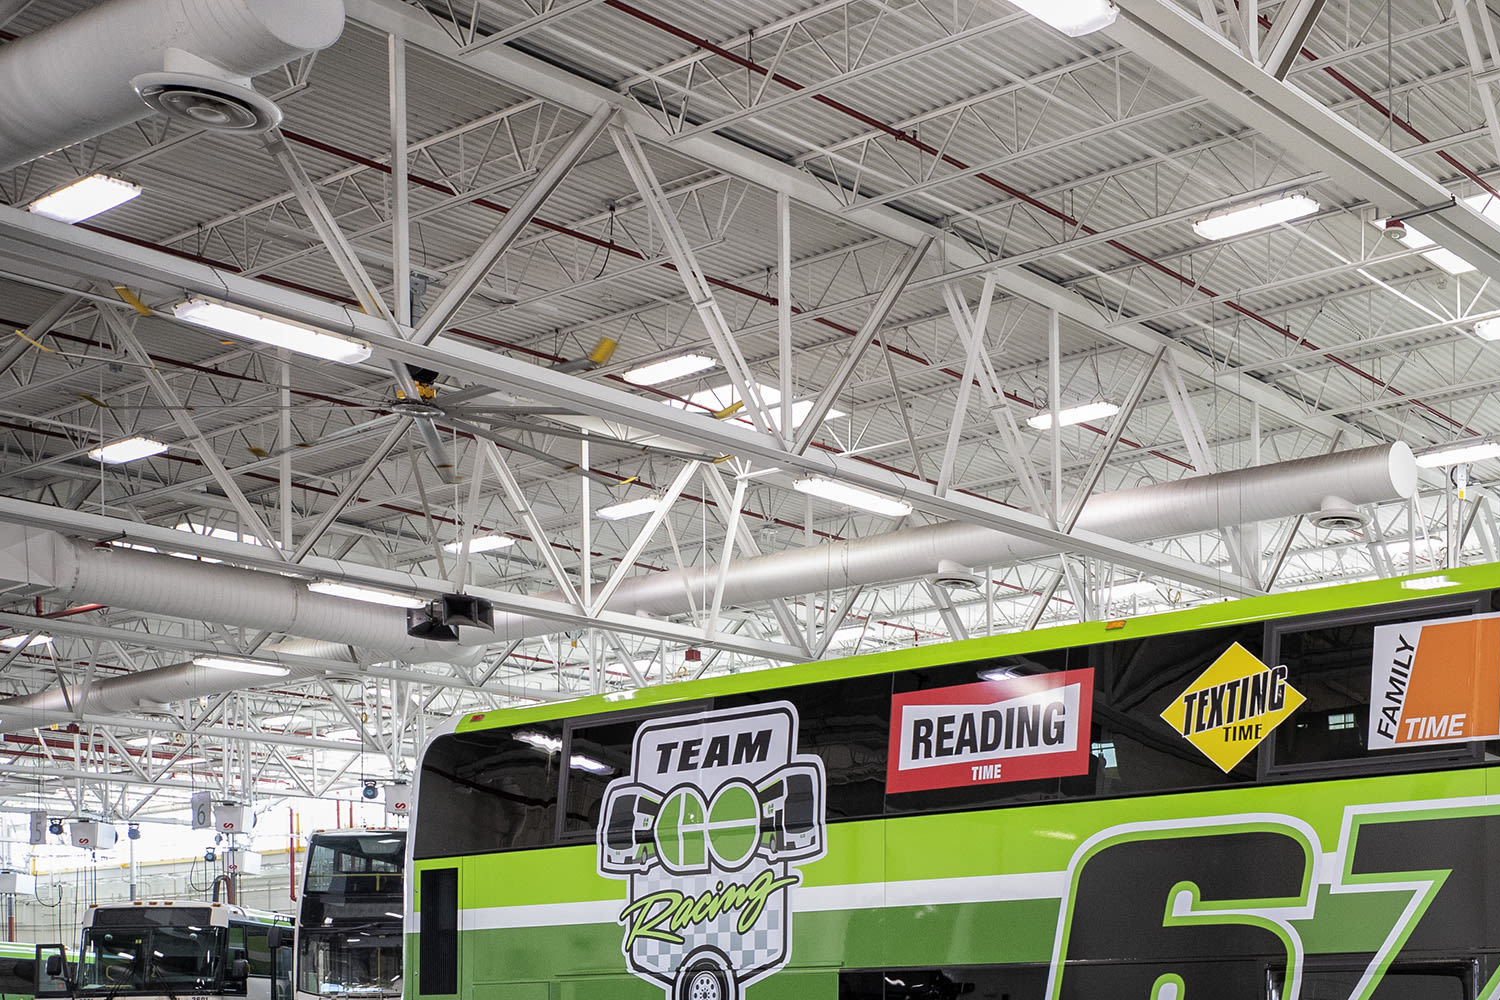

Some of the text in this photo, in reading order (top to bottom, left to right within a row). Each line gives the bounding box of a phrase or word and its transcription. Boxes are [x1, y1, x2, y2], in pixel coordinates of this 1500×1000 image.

[1182, 664, 1289, 738] TEXTING
[1376, 633, 1416, 740] FAMILY
[911, 701, 1067, 761] READING
[1223, 723, 1263, 742] TIME
[1405, 713, 1467, 741] TIME
[656, 729, 773, 774] TEAM
[971, 763, 1003, 781] TIME
[35, 822, 42, 842] 5
[197, 803, 206, 826] 6
[655, 784, 760, 867] GO
[620, 868, 799, 951] Racing
